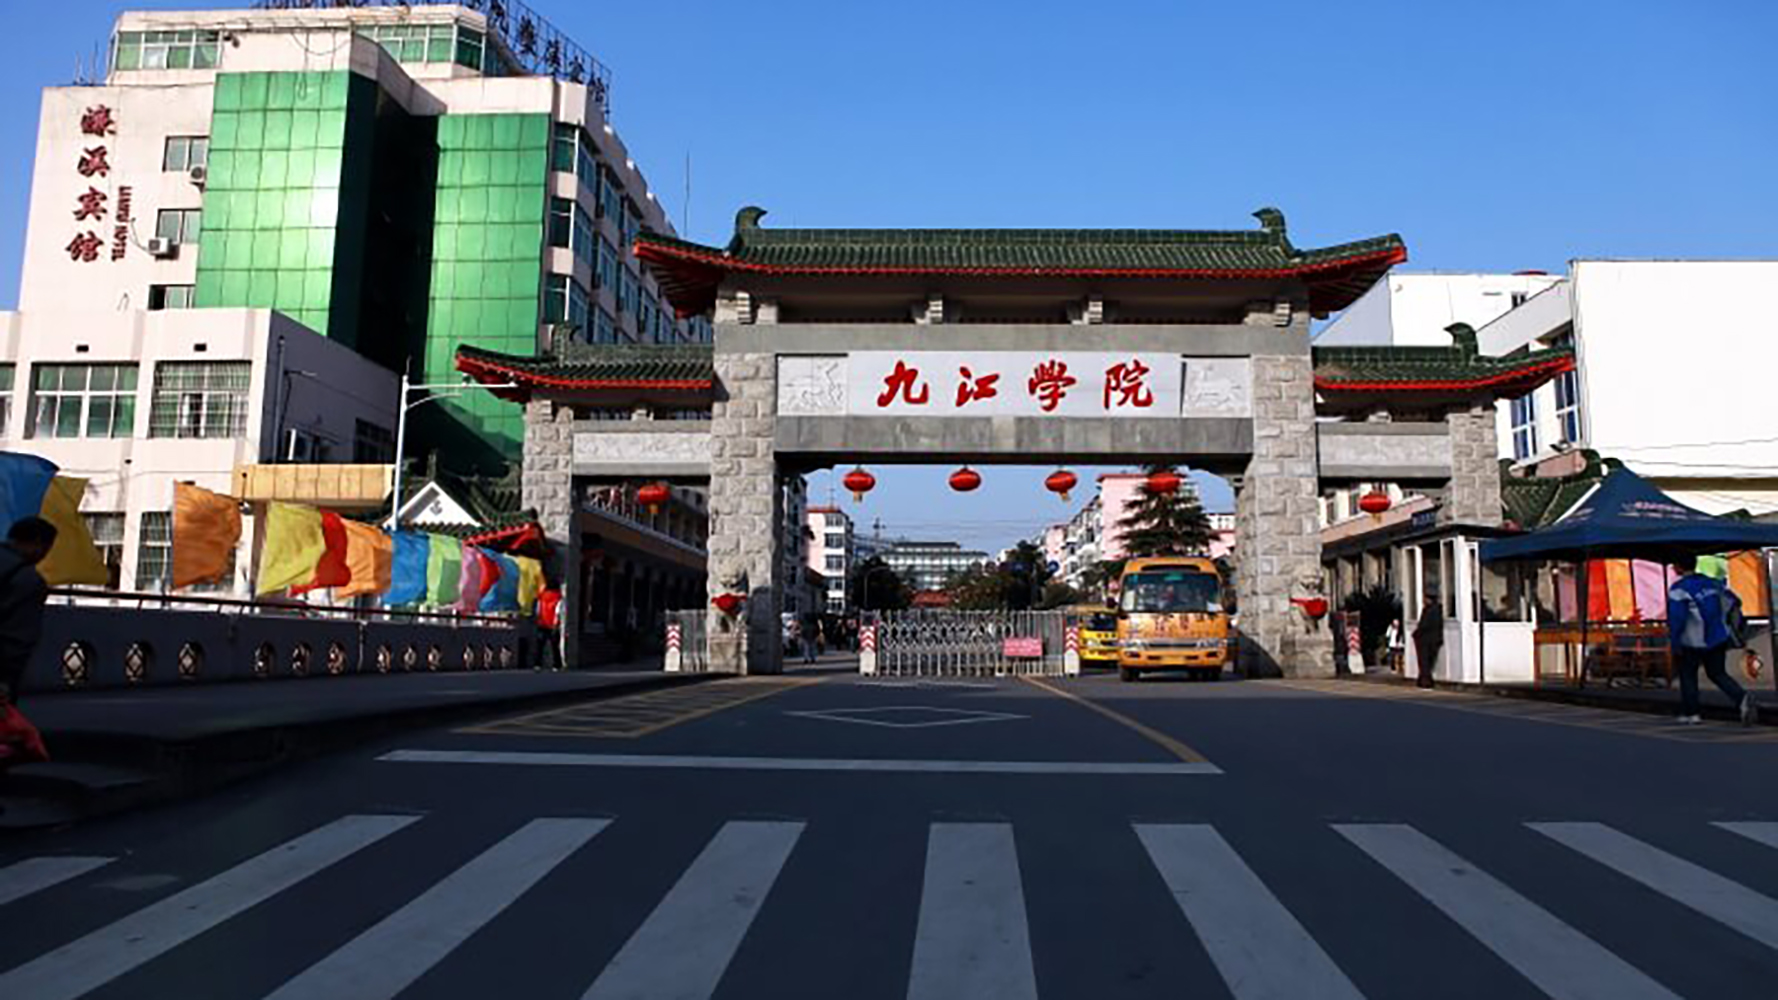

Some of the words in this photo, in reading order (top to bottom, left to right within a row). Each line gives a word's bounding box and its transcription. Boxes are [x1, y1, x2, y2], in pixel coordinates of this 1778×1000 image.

[65, 103, 117, 263] 濂溪宾馆
[111, 225, 128, 262] HOTEL
